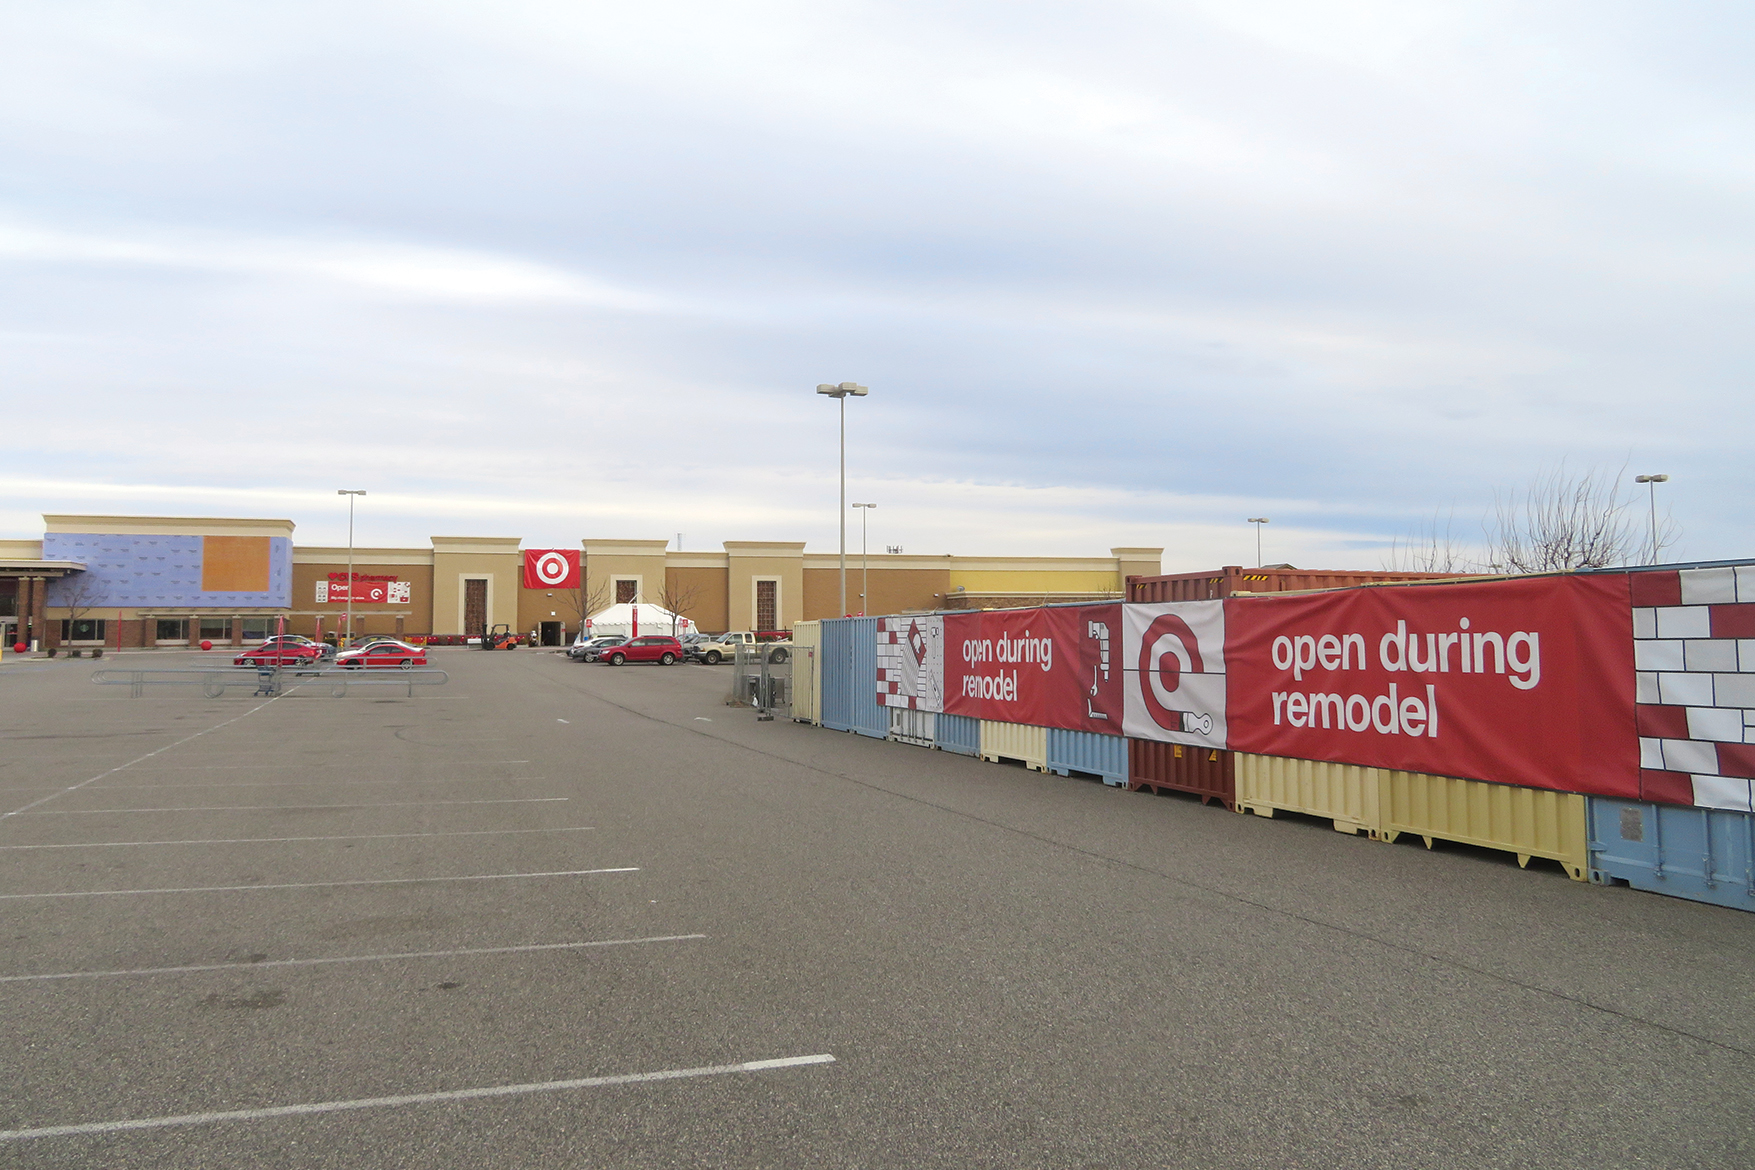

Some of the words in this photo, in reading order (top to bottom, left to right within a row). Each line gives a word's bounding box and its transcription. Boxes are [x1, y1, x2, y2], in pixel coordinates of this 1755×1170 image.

[962, 639, 993, 669] open
[996, 629, 1052, 672] during
[1271, 633, 1366, 681] open
[1379, 617, 1541, 690] during
[962, 668, 1018, 701] remodel
[1271, 683, 1438, 738] remodel
